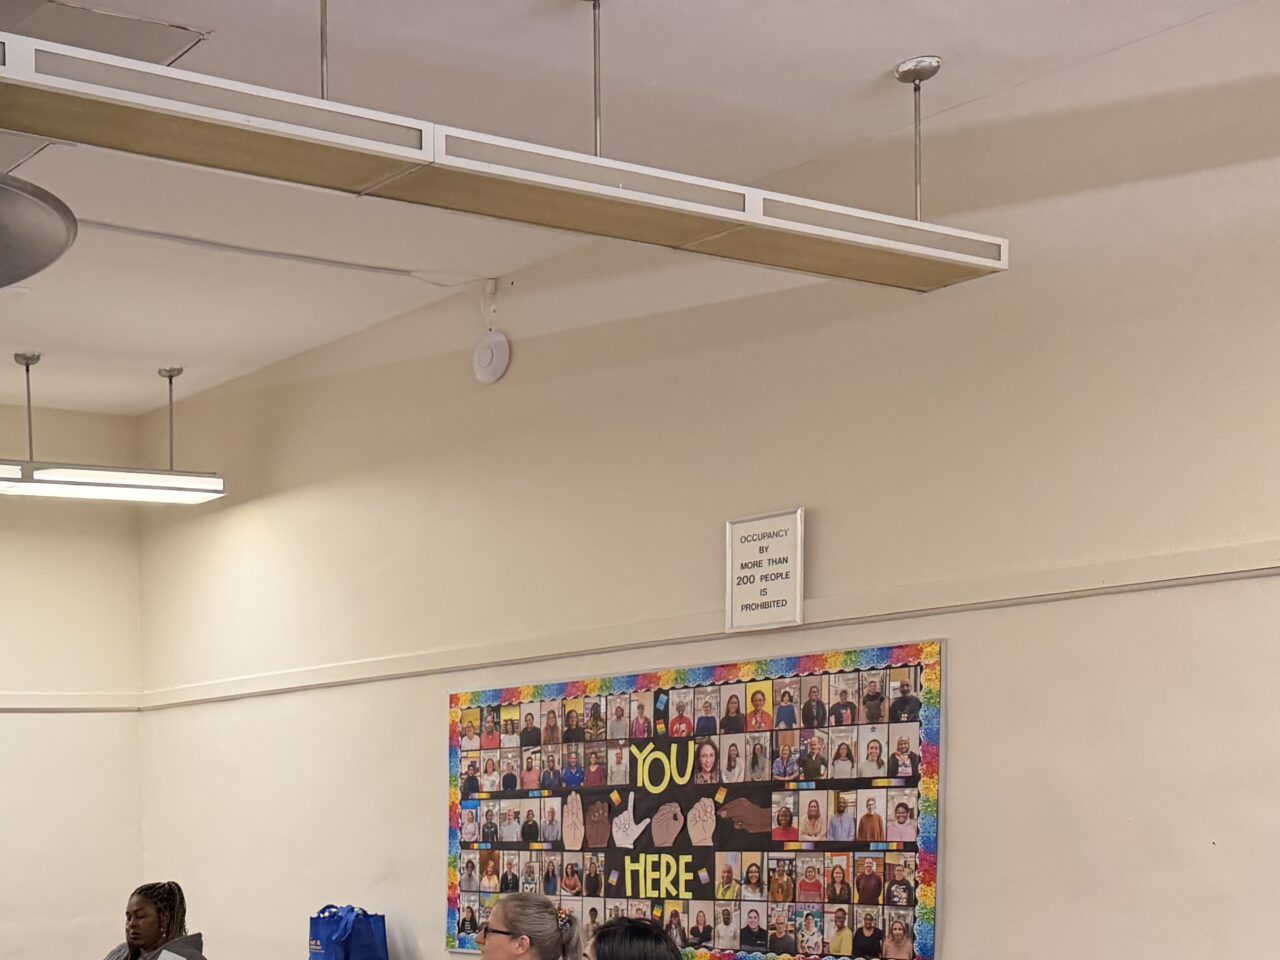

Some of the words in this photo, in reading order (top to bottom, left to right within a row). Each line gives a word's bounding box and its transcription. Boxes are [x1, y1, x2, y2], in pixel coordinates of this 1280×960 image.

[740, 528, 790, 544] OCCUPANCY
[758, 545, 770, 554] BY
[740, 560, 763, 570] MORE
[767, 556, 789, 567] THAN
[736, 574, 756, 586] 200
[760, 571, 791, 583] PEOPLE
[759, 588, 768, 597] IS
[740, 599, 788, 612] PROHIBITED
[629, 740, 695, 794] YOU
[624, 853, 694, 899] HERE
